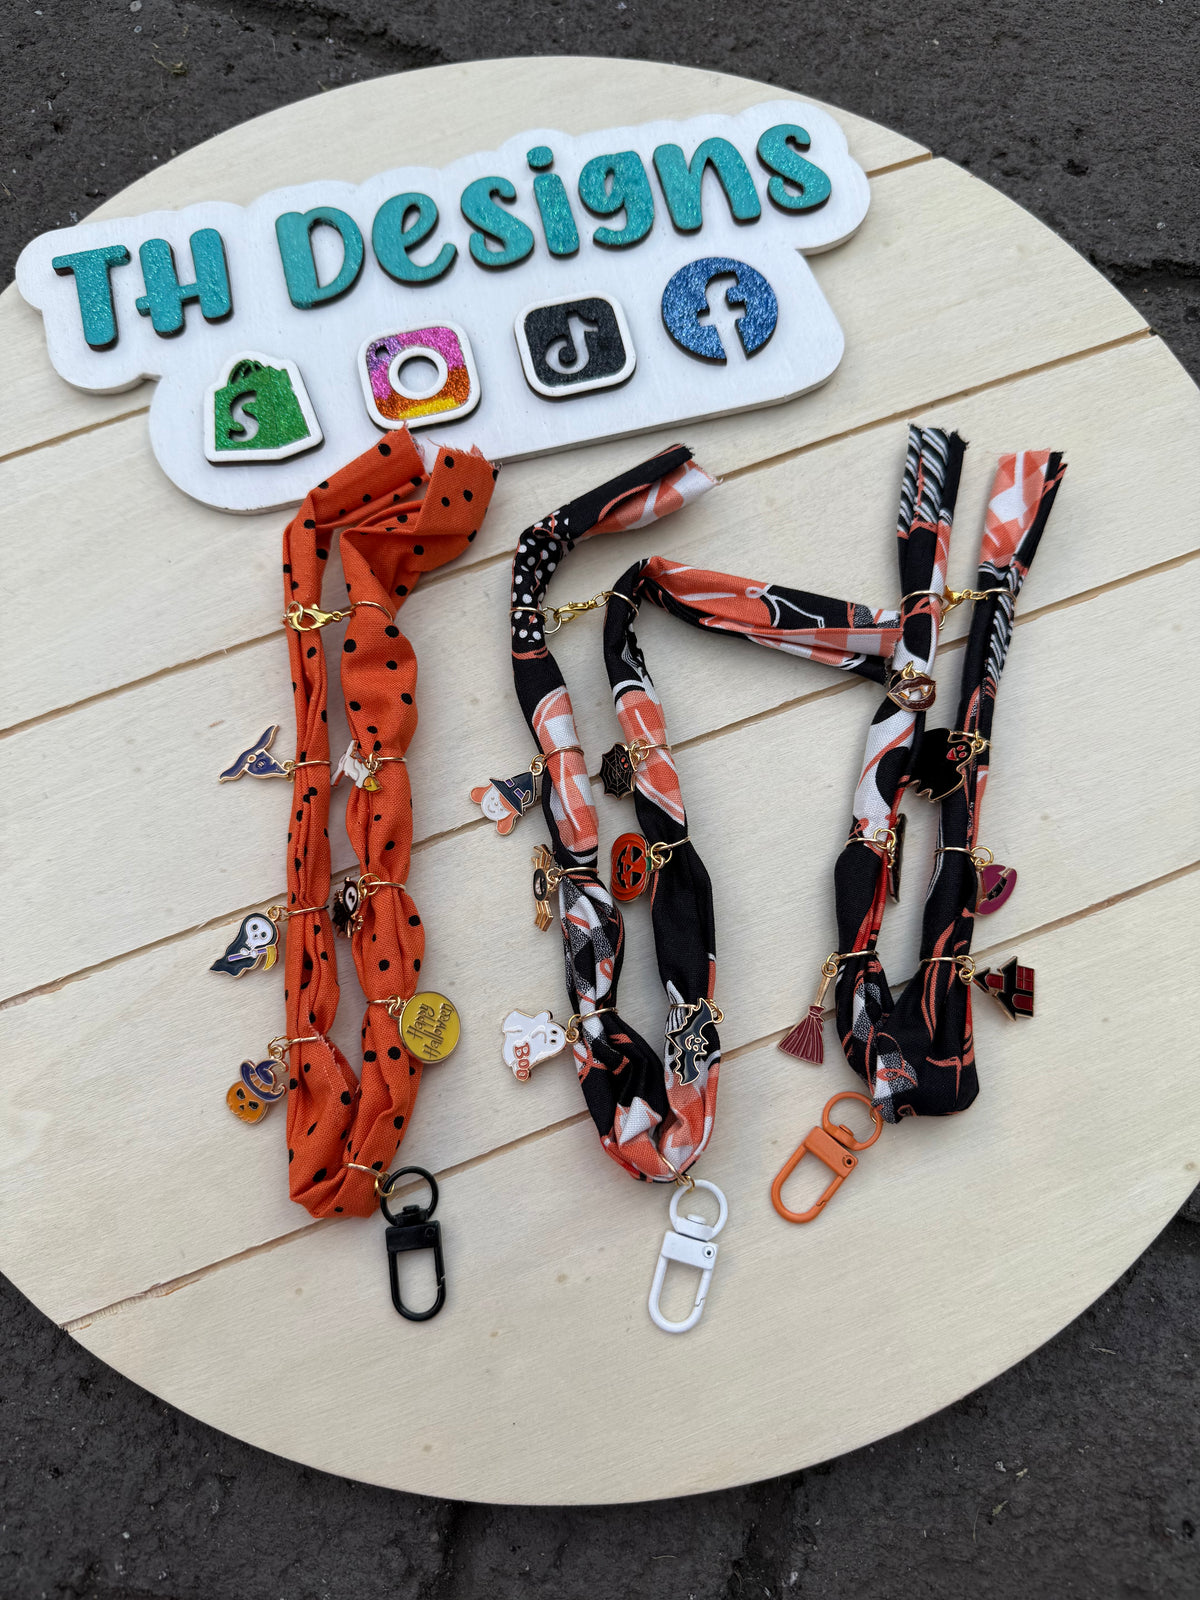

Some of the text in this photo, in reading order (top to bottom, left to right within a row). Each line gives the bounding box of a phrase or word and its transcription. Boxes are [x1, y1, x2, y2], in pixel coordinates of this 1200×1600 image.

[53, 124, 833, 351] TH Designs
[406, 1002, 436, 1040] Happy
[422, 1002, 455, 1059] Halloween
[514, 1042, 530, 1080] BOO
